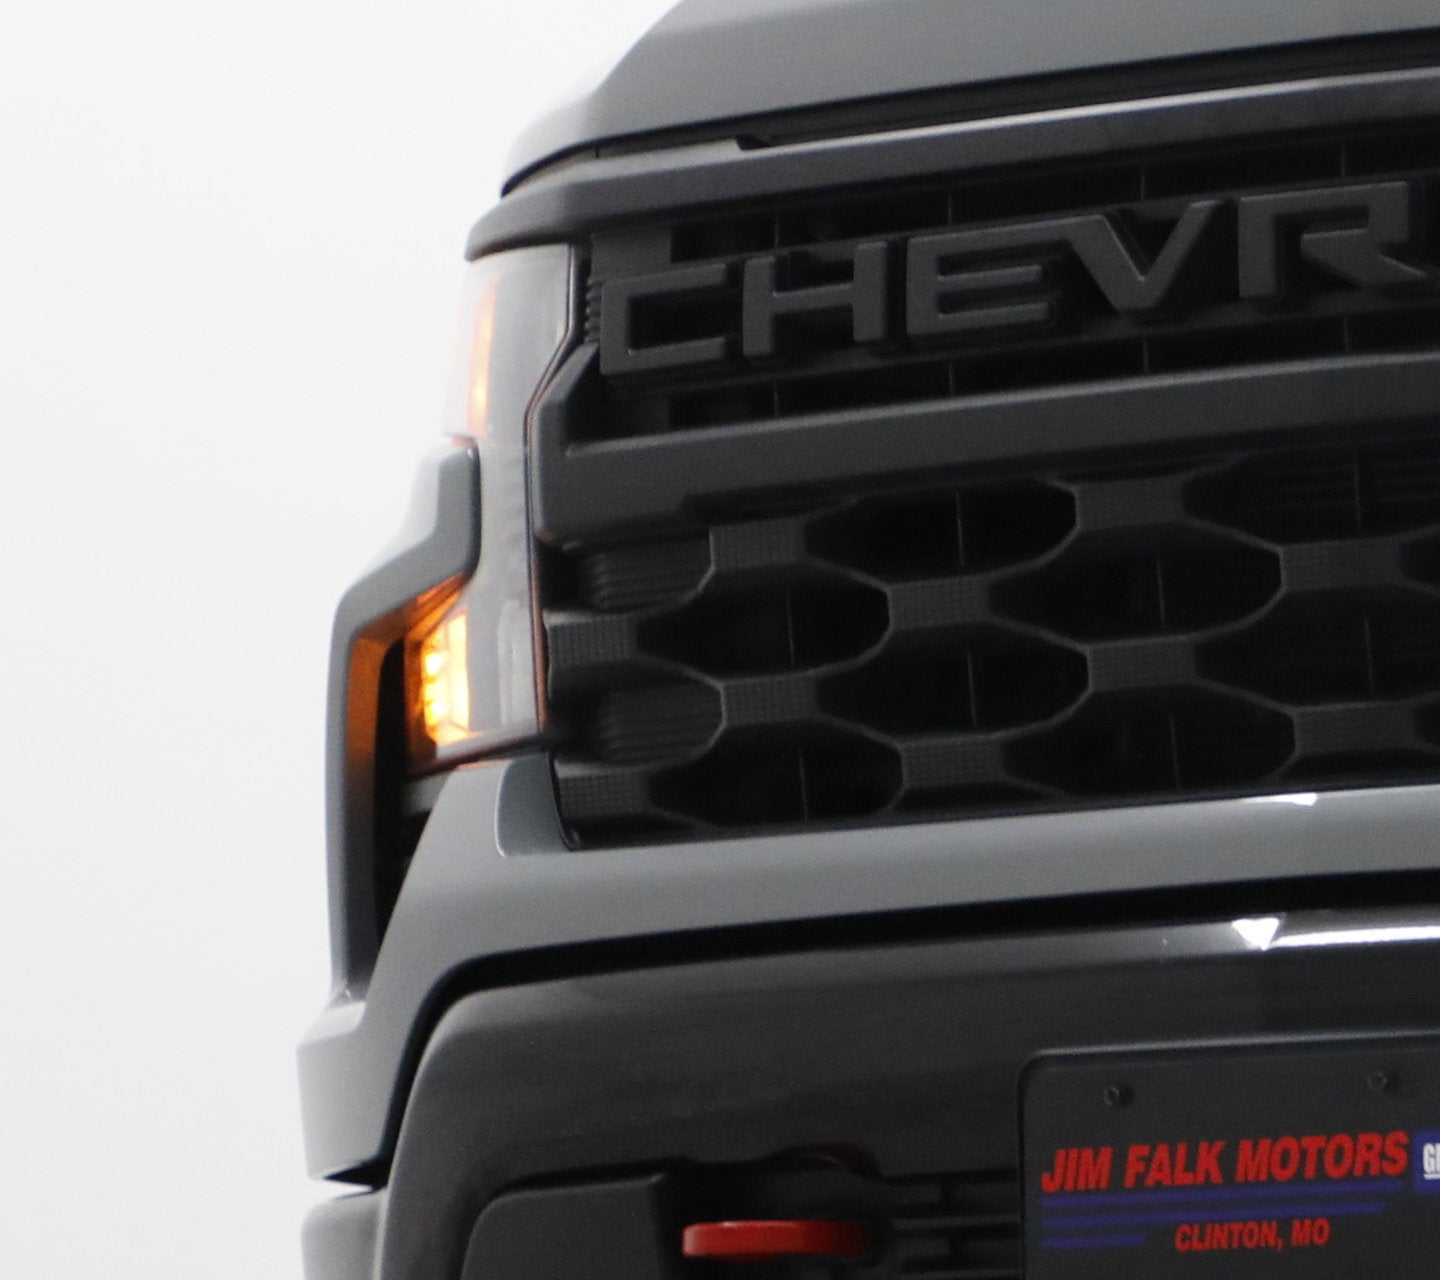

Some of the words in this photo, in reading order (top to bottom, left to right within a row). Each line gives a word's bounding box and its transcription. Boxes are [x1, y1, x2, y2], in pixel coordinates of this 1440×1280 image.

[1041, 1147, 1113, 1192] JIM
[1124, 1139, 1227, 1188] FALK
[1235, 1131, 1410, 1180] MOTORS
[1174, 1223, 1284, 1252] CLINTON,
[1291, 1219, 1330, 1246] MO
